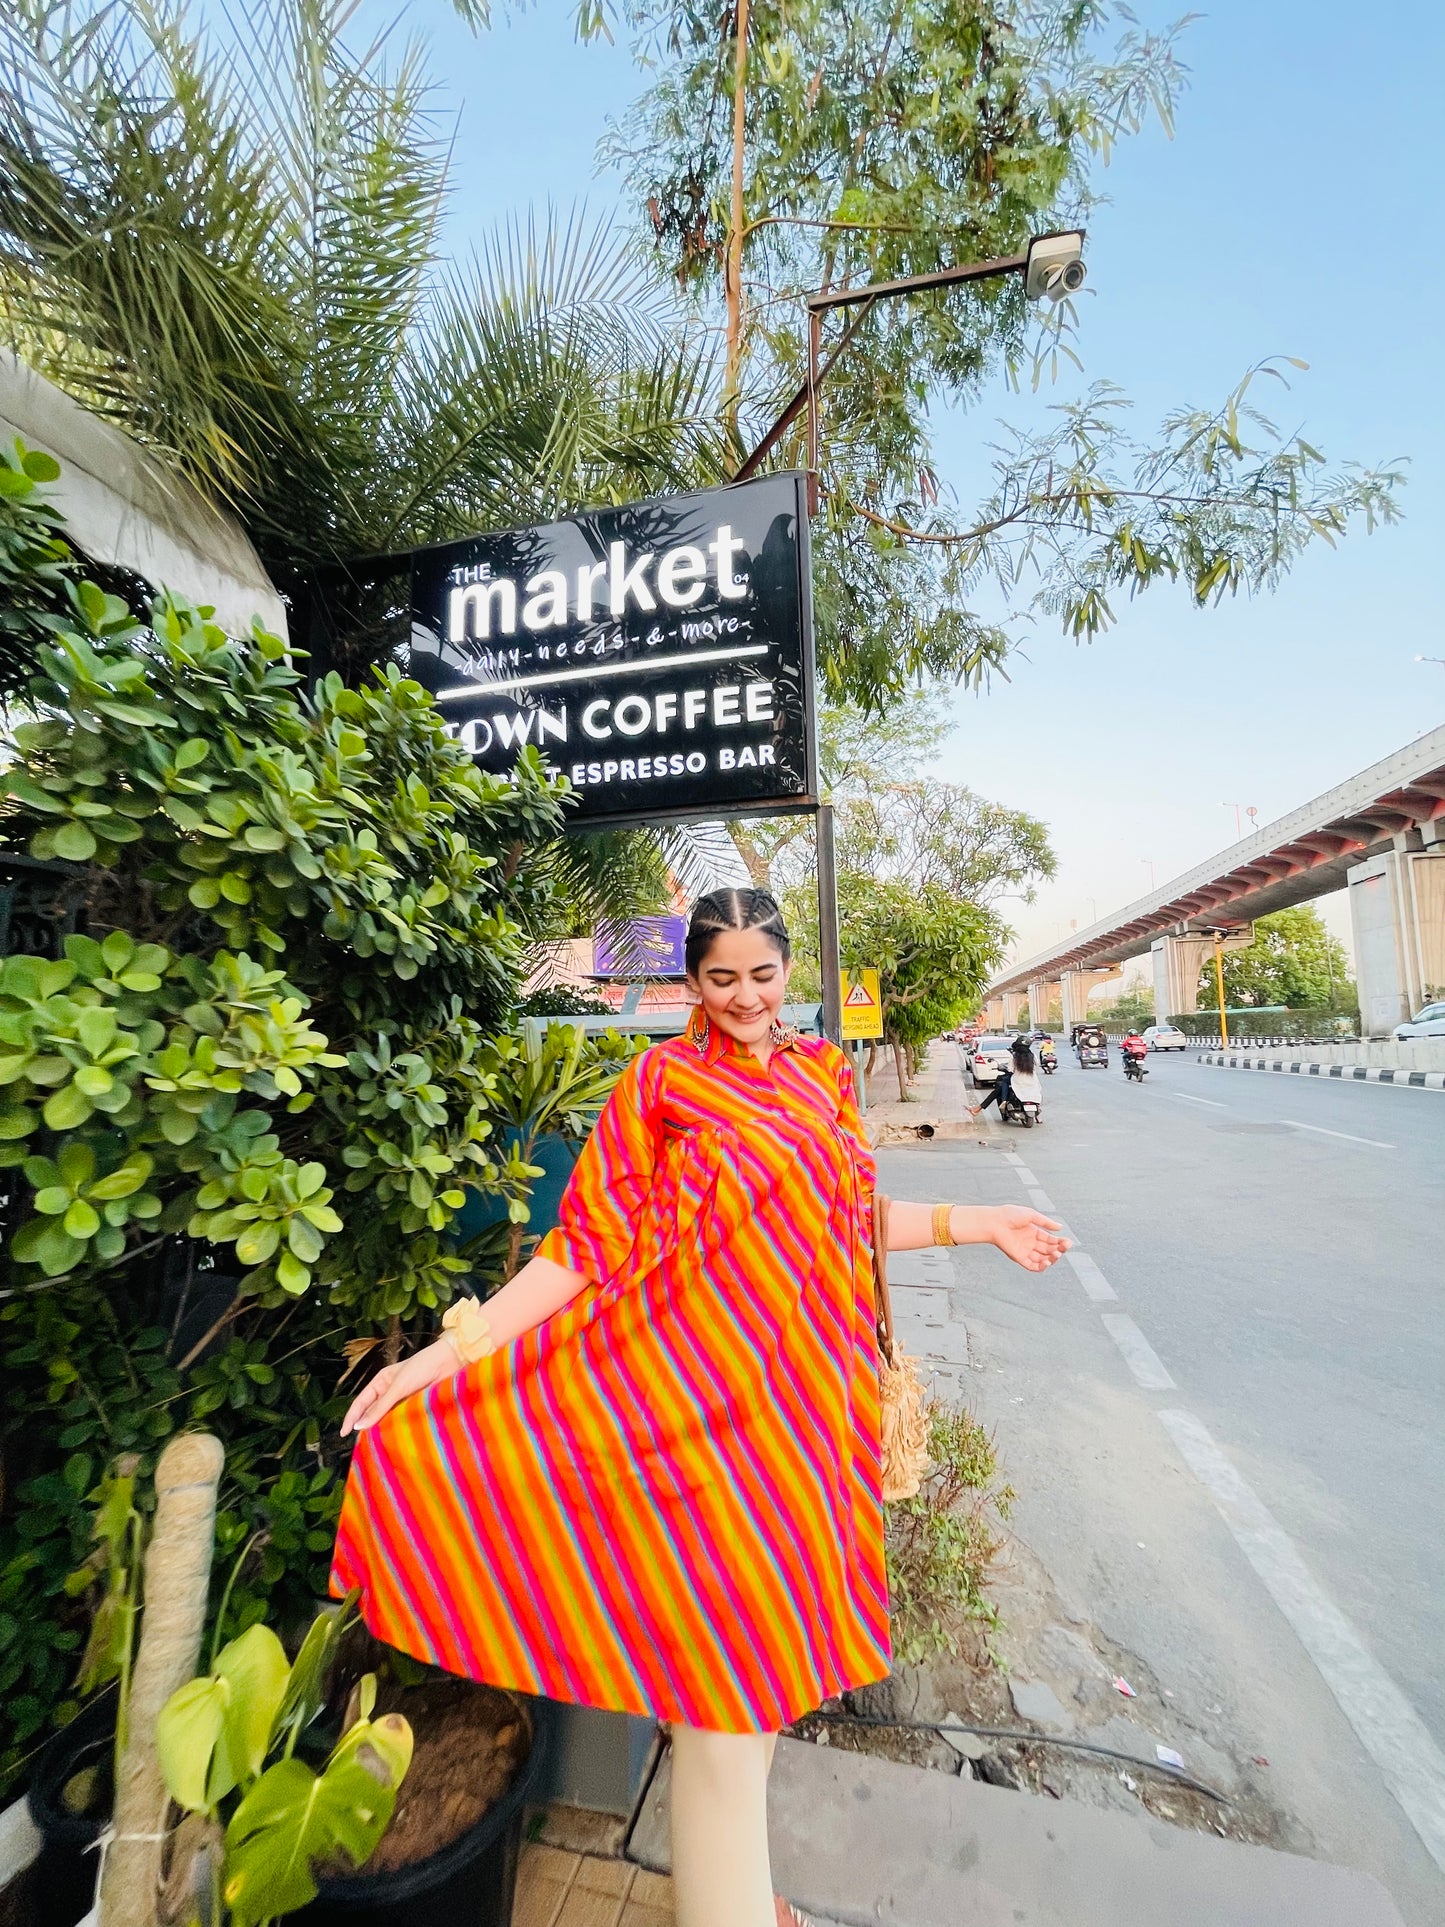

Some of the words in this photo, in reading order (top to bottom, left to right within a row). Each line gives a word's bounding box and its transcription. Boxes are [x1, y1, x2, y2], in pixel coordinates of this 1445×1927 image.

[450, 525, 747, 642] market
[452, 562, 491, 585] THE
[582, 682, 775, 739] COFFEE
[572, 752, 706, 785] ESPRESSO
[719, 744, 776, 770] BAR
